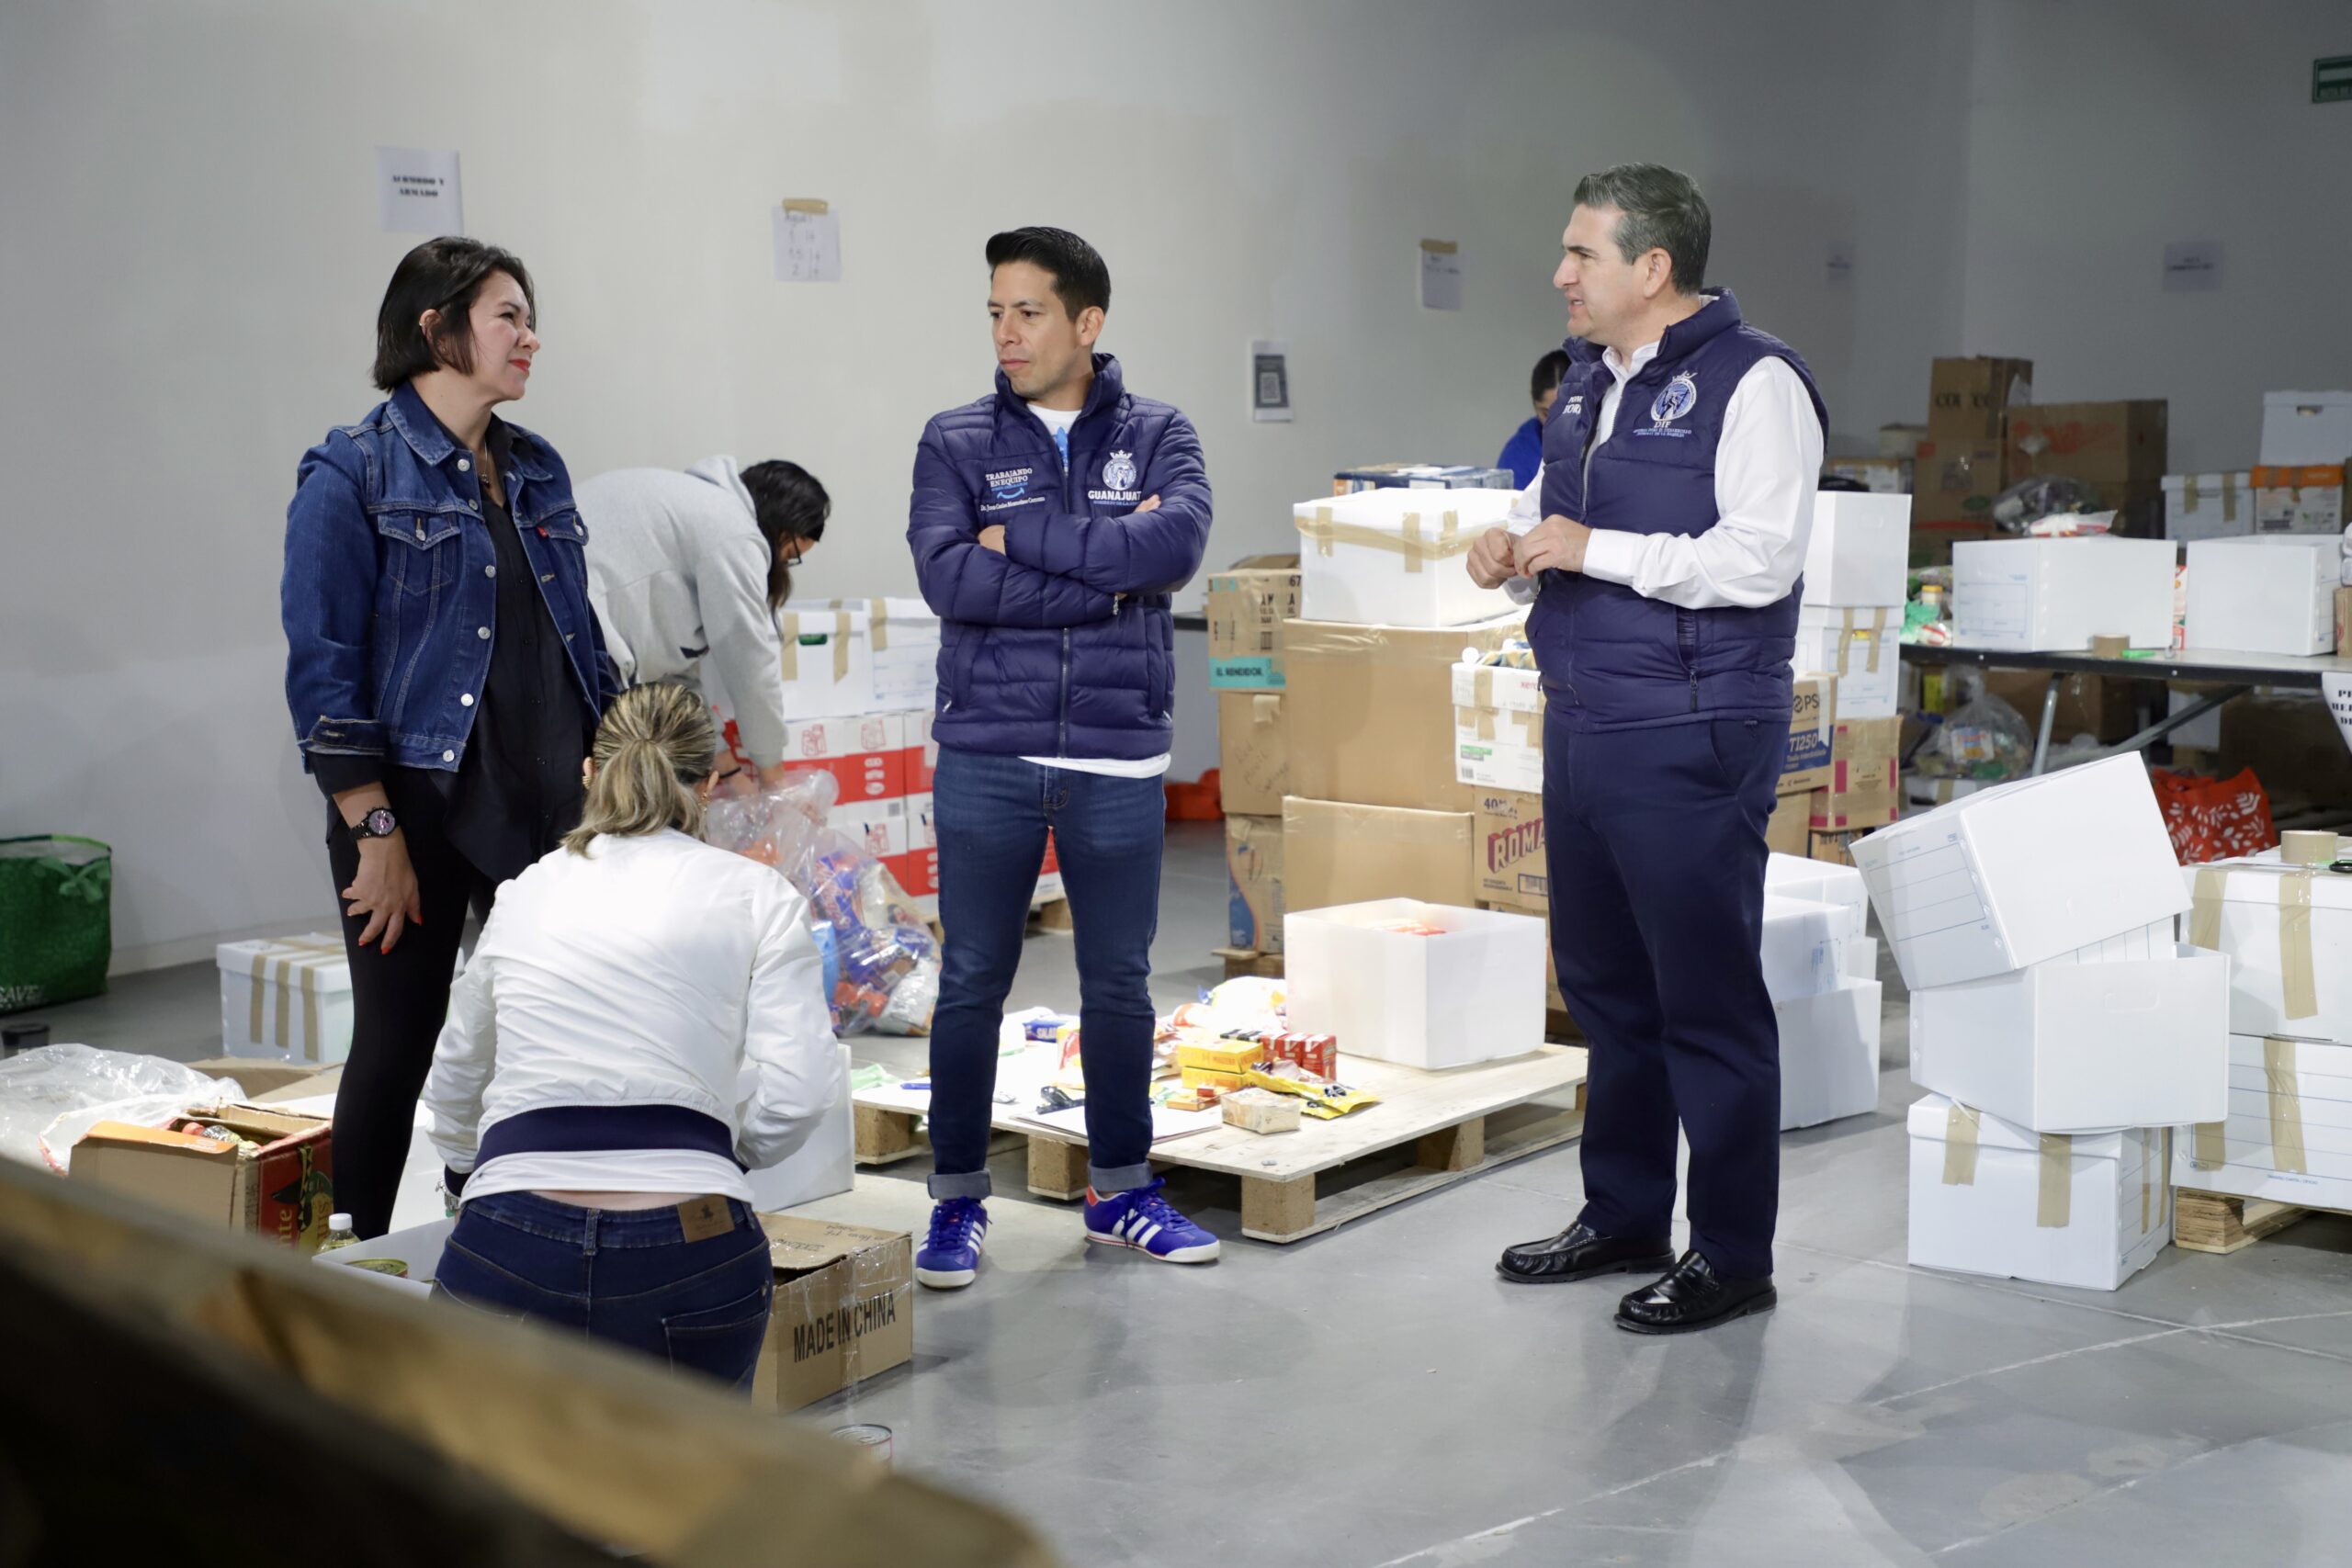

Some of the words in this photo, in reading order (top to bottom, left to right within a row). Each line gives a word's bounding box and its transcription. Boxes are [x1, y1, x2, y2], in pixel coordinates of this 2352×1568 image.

[985, 468, 1033, 481] TRABAJANDO
[1001, 475, 1028, 486] EQUIPO
[1087, 490, 1142, 502] GUANAJUAT
[1790, 732, 1819, 752] TI250
[794, 1312, 834, 1363] MADE
[837, 1307, 852, 1346] IN
[854, 1290, 897, 1338] CHINA
